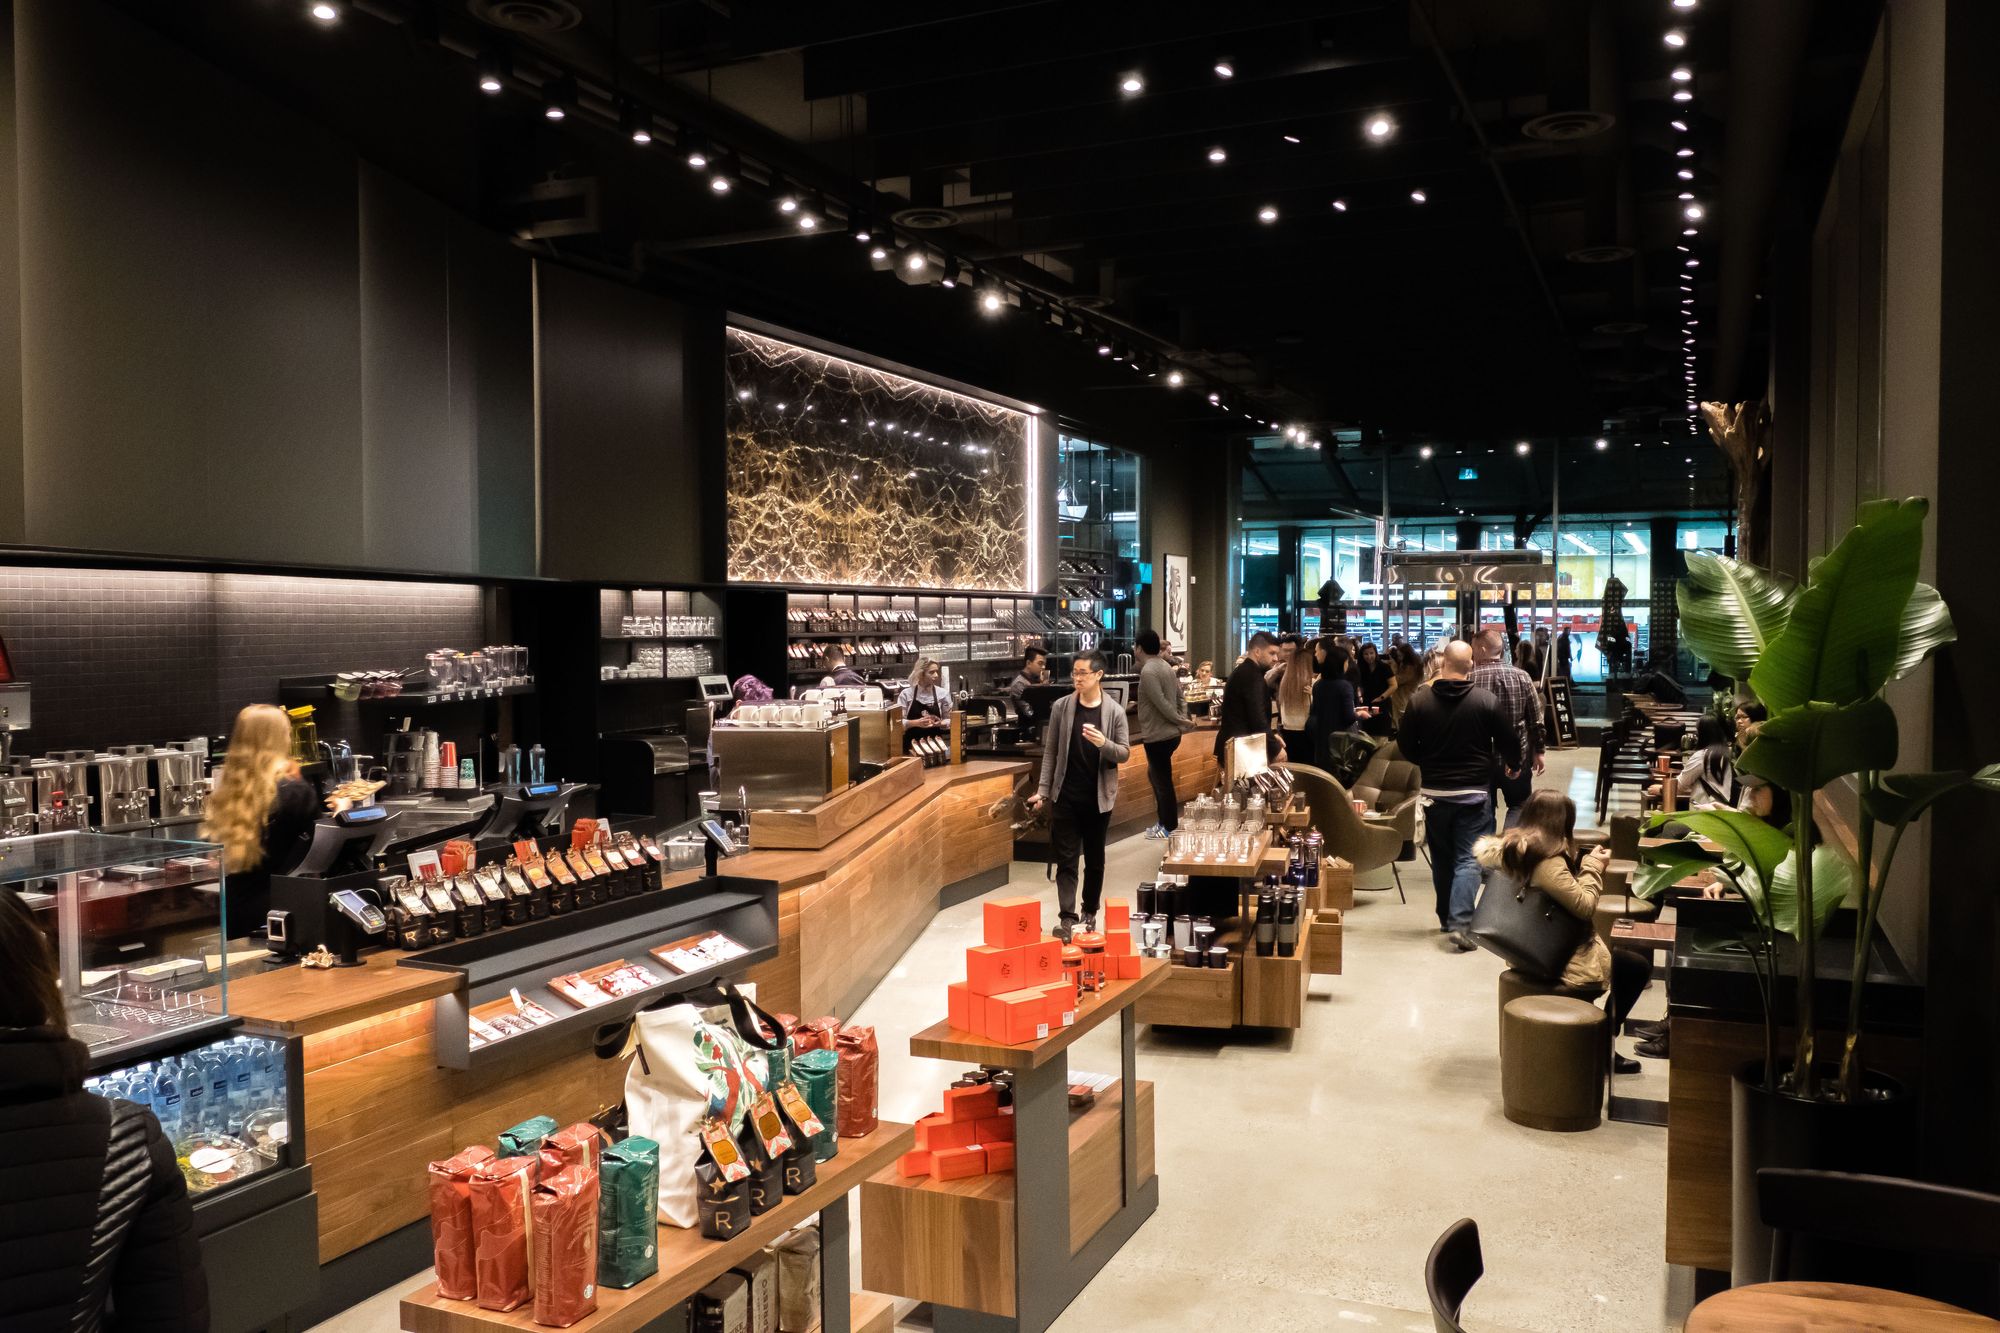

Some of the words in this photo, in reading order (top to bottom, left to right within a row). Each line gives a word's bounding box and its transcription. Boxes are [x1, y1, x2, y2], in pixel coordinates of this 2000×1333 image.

[405, 930, 416, 943] R
[785, 1167, 801, 1186] R
[751, 1188, 765, 1206] R
[715, 1211, 732, 1231] R
